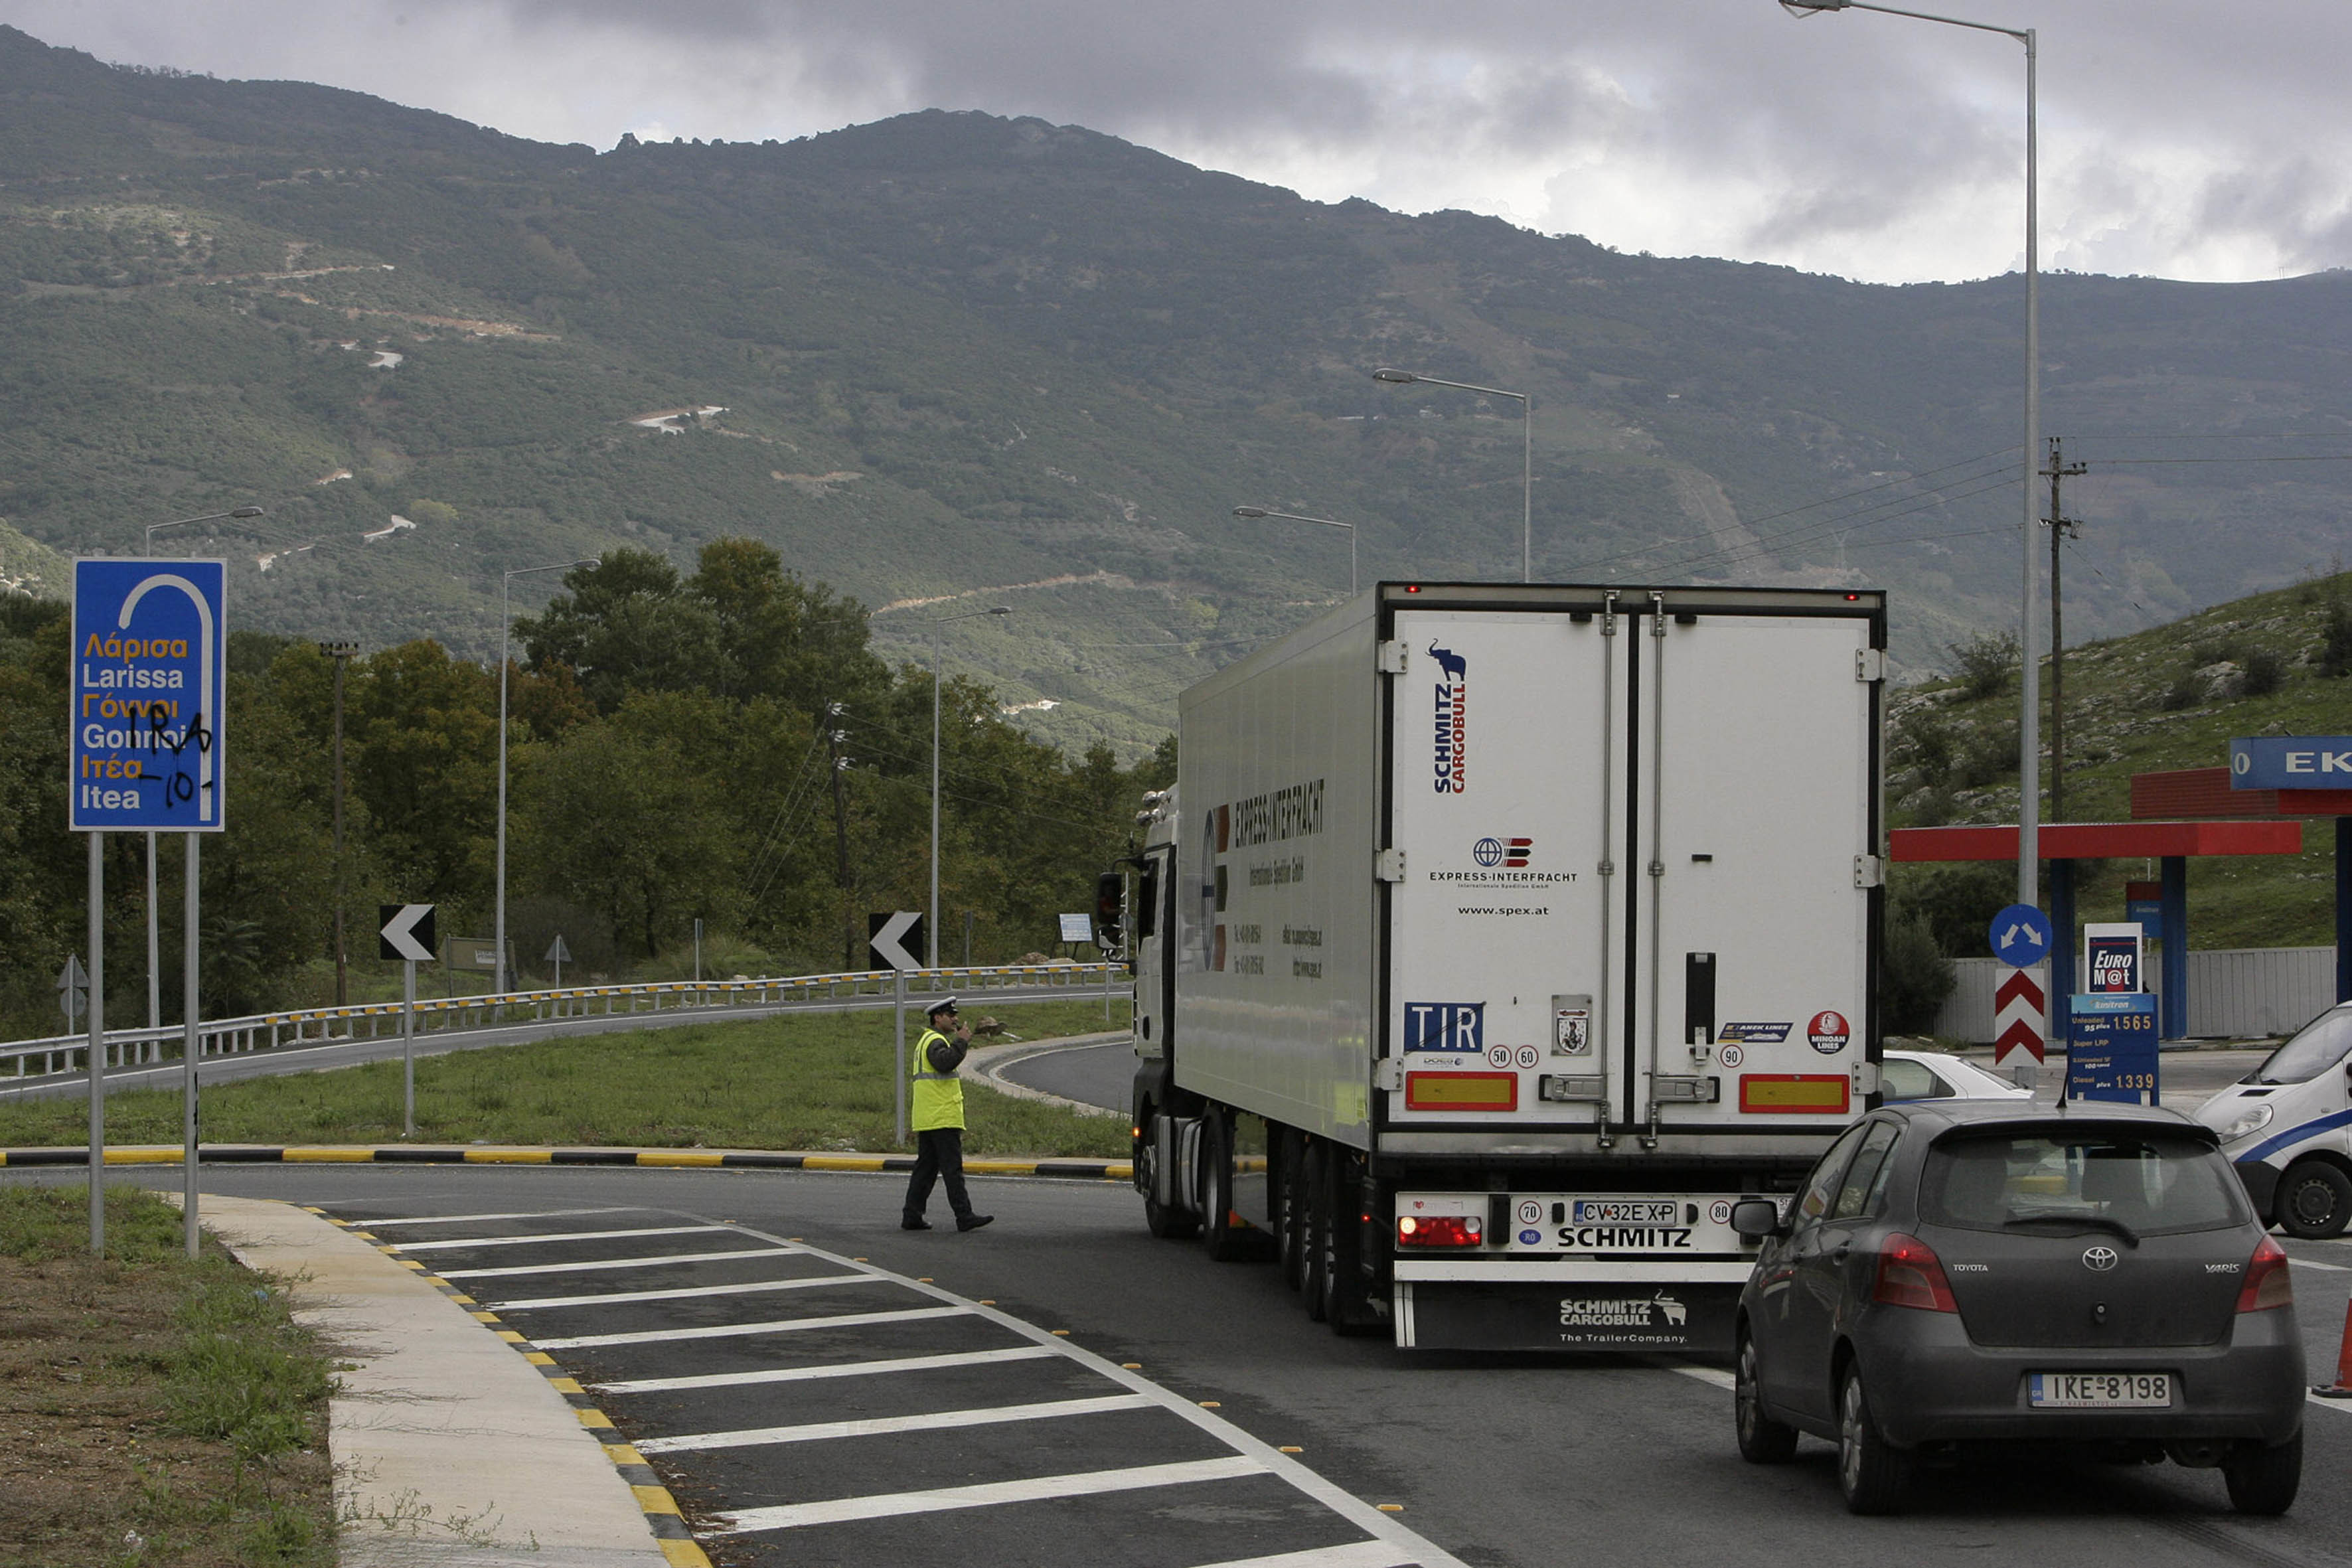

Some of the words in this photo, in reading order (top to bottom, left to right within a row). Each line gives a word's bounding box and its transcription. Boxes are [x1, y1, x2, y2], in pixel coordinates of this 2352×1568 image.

[84, 632, 188, 663] Λάρισα
[84, 664, 183, 689] Larissa
[82, 692, 178, 718] Γόννοι
[82, 723, 187, 749] Gonnoi
[1435, 683, 1451, 793] SCHMITZ
[1452, 684, 1465, 794] CARGOBULL
[82, 753, 142, 779] Ιτέα
[82, 785, 140, 810] Itea
[1458, 907, 1549, 916] www.spex.at
[1411, 1006, 1476, 1049] TIR
[1494, 1050, 1507, 1062] 50
[1521, 1051, 1533, 1063] 60
[1725, 1051, 1737, 1062] 90
[1524, 1206, 1537, 1218] 70
[1714, 1205, 1727, 1219] 80
[1525, 1233, 1535, 1241] RO
[1558, 1227, 1691, 1247] SCHMITZ
[2204, 1263, 2240, 1274] YARIS
[1560, 1299, 1651, 1314] SCHMITZ
[1560, 1314, 1651, 1326] CARGOBULL
